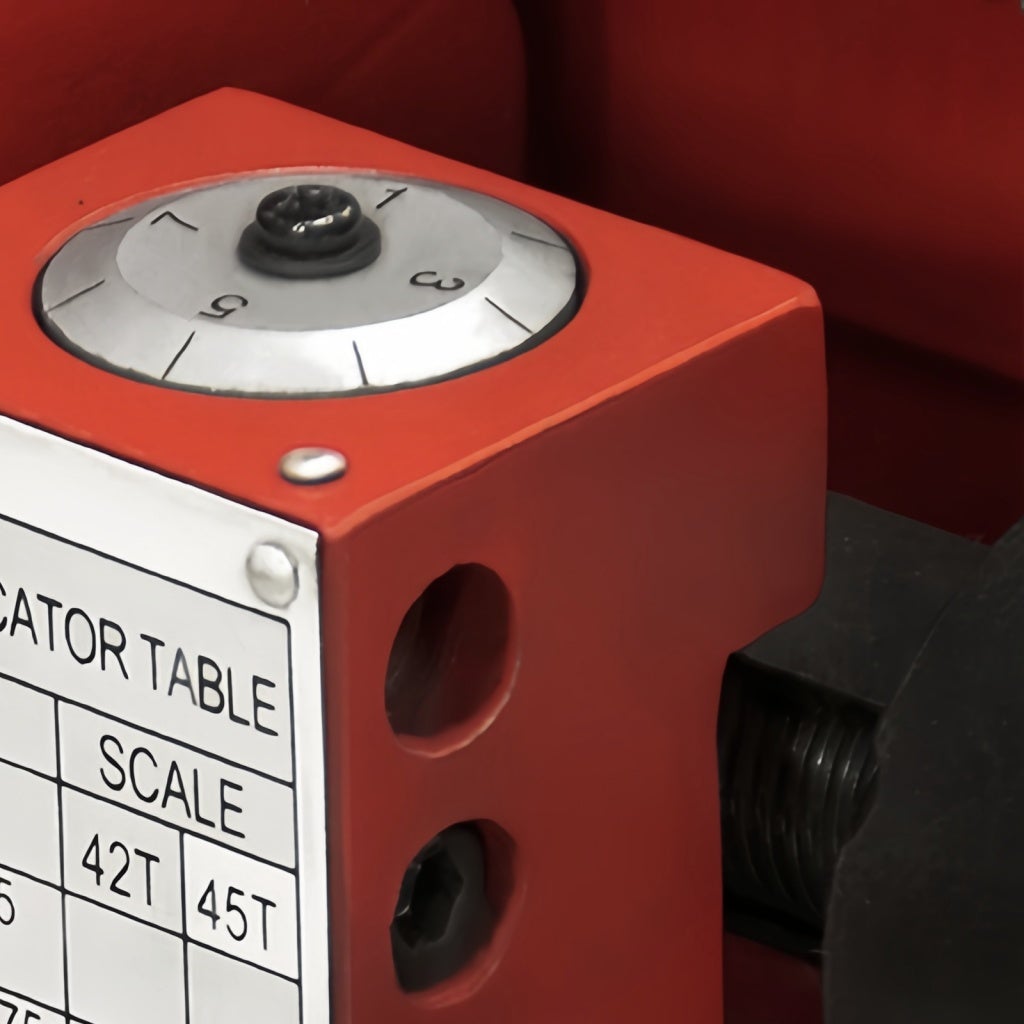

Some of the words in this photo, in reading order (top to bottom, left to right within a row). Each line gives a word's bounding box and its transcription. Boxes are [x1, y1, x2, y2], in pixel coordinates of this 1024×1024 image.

[376, 186, 408, 209] 1
[151, 211, 198, 232] 7
[410, 271, 465, 291] 3
[199, 295, 248, 319] 5
[141, 633, 279, 736] TABLE
[99, 734, 247, 839] SCALE
[81, 834, 159, 905] 42T
[197, 880, 276, 950] 45T
